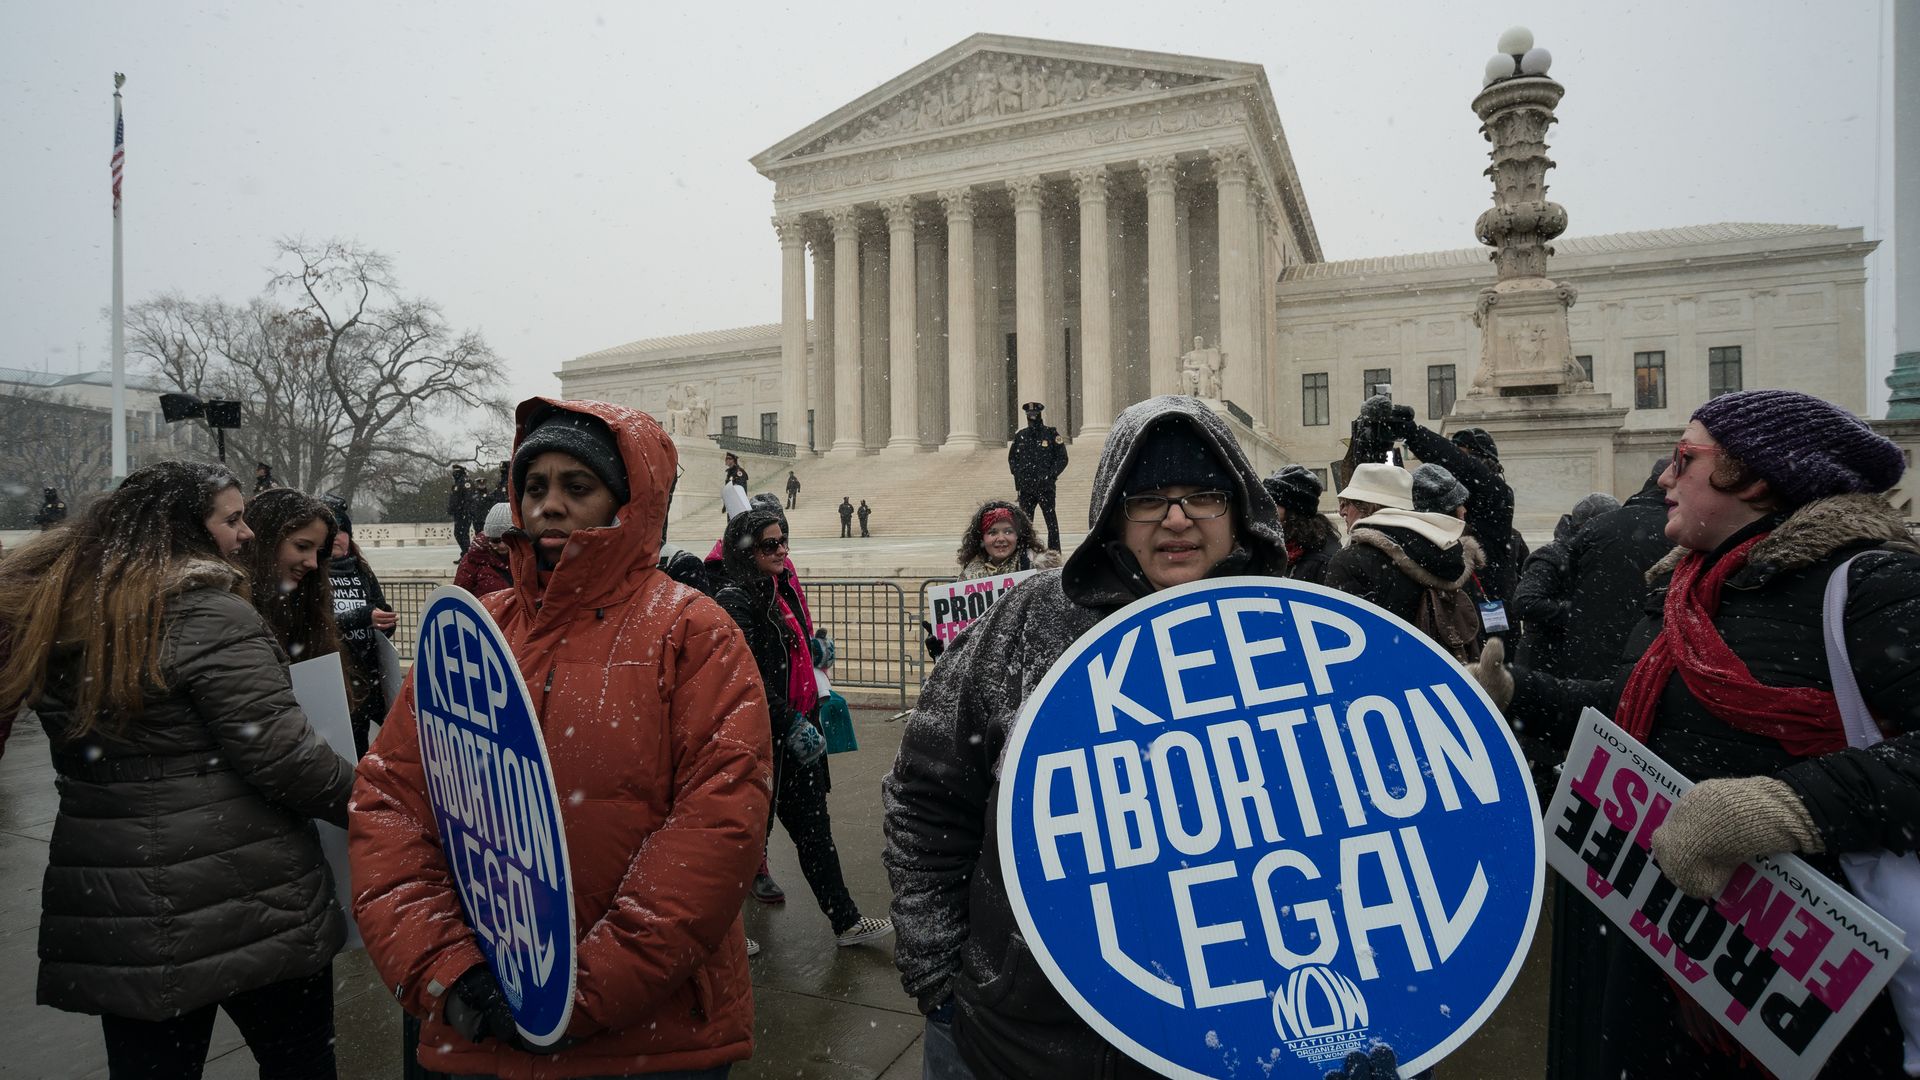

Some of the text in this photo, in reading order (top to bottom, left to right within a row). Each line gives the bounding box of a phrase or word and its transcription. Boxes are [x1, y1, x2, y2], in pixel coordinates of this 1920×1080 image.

[329, 577, 361, 586] THIS IS
[964, 581, 994, 595] AM
[1003, 578, 1015, 589] A
[424, 610, 508, 735] KEEP
[1088, 597, 1366, 733] KEEP
[422, 709, 558, 892] ABORTION
[1033, 683, 1500, 881] ABORTION
[446, 819, 555, 988] LEGAL
[1090, 826, 1488, 1008] LEGAL
[1555, 789, 1836, 1057] PROLIFE
[1570, 744, 1875, 1014] FEMIST
[1586, 864, 1614, 900] A
[1629, 909, 1709, 984] AM
[1273, 966, 1369, 1040] NOW
[1288, 1031, 1366, 1050] NATIONAL
[1297, 1041, 1361, 1056] ORGANIZATION
[1324, 1051, 1345, 1059] WOM
